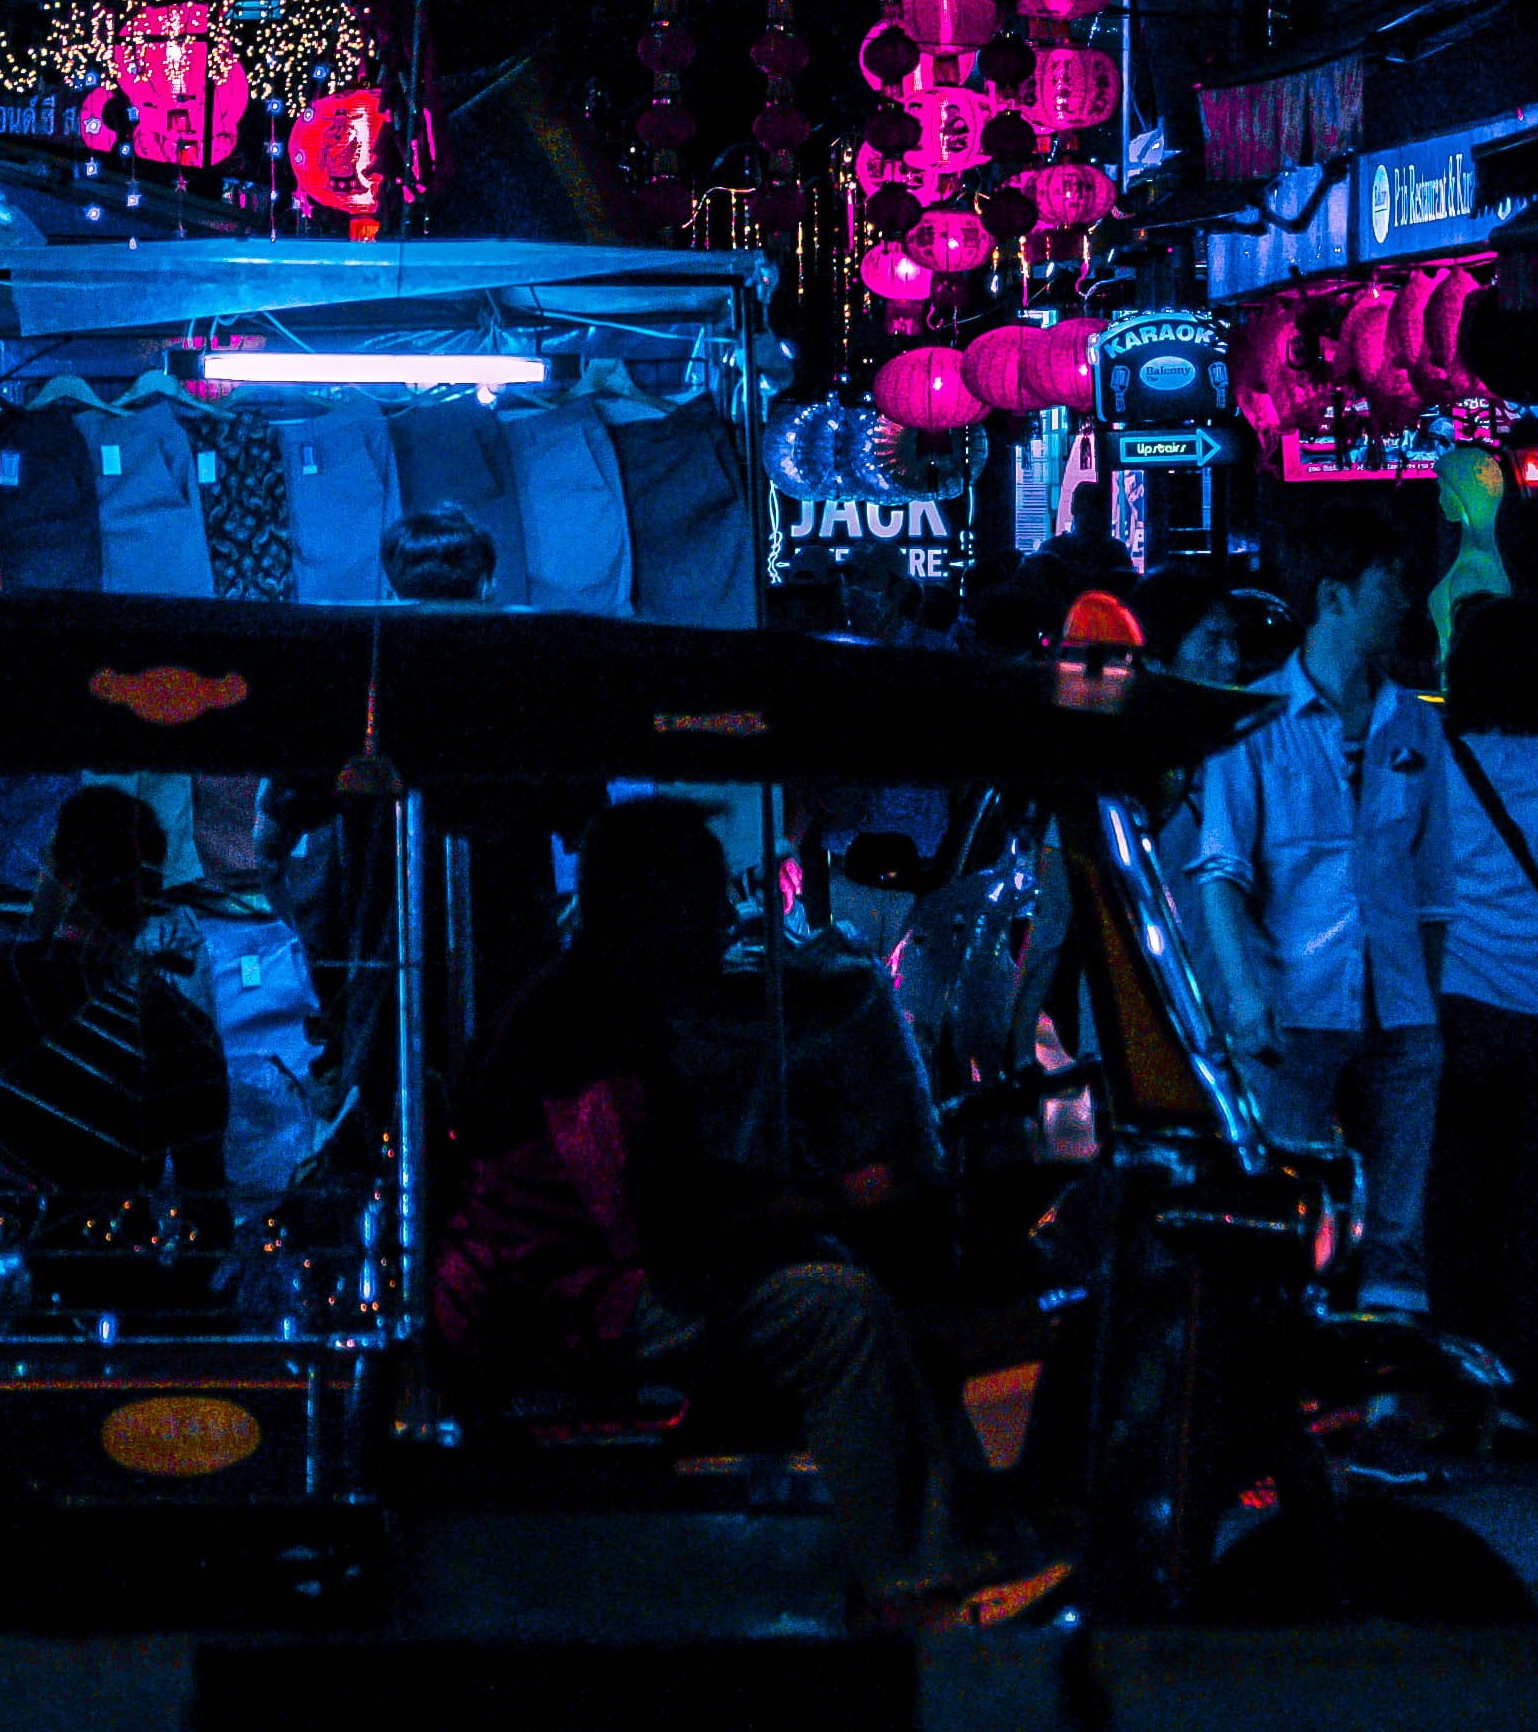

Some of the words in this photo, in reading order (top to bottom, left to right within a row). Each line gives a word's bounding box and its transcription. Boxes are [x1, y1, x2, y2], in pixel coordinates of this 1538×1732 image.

[1104, 323, 1216, 360] KARAOK
[1136, 441, 1187, 456] Upstairs
[790, 499, 949, 539] JACK
